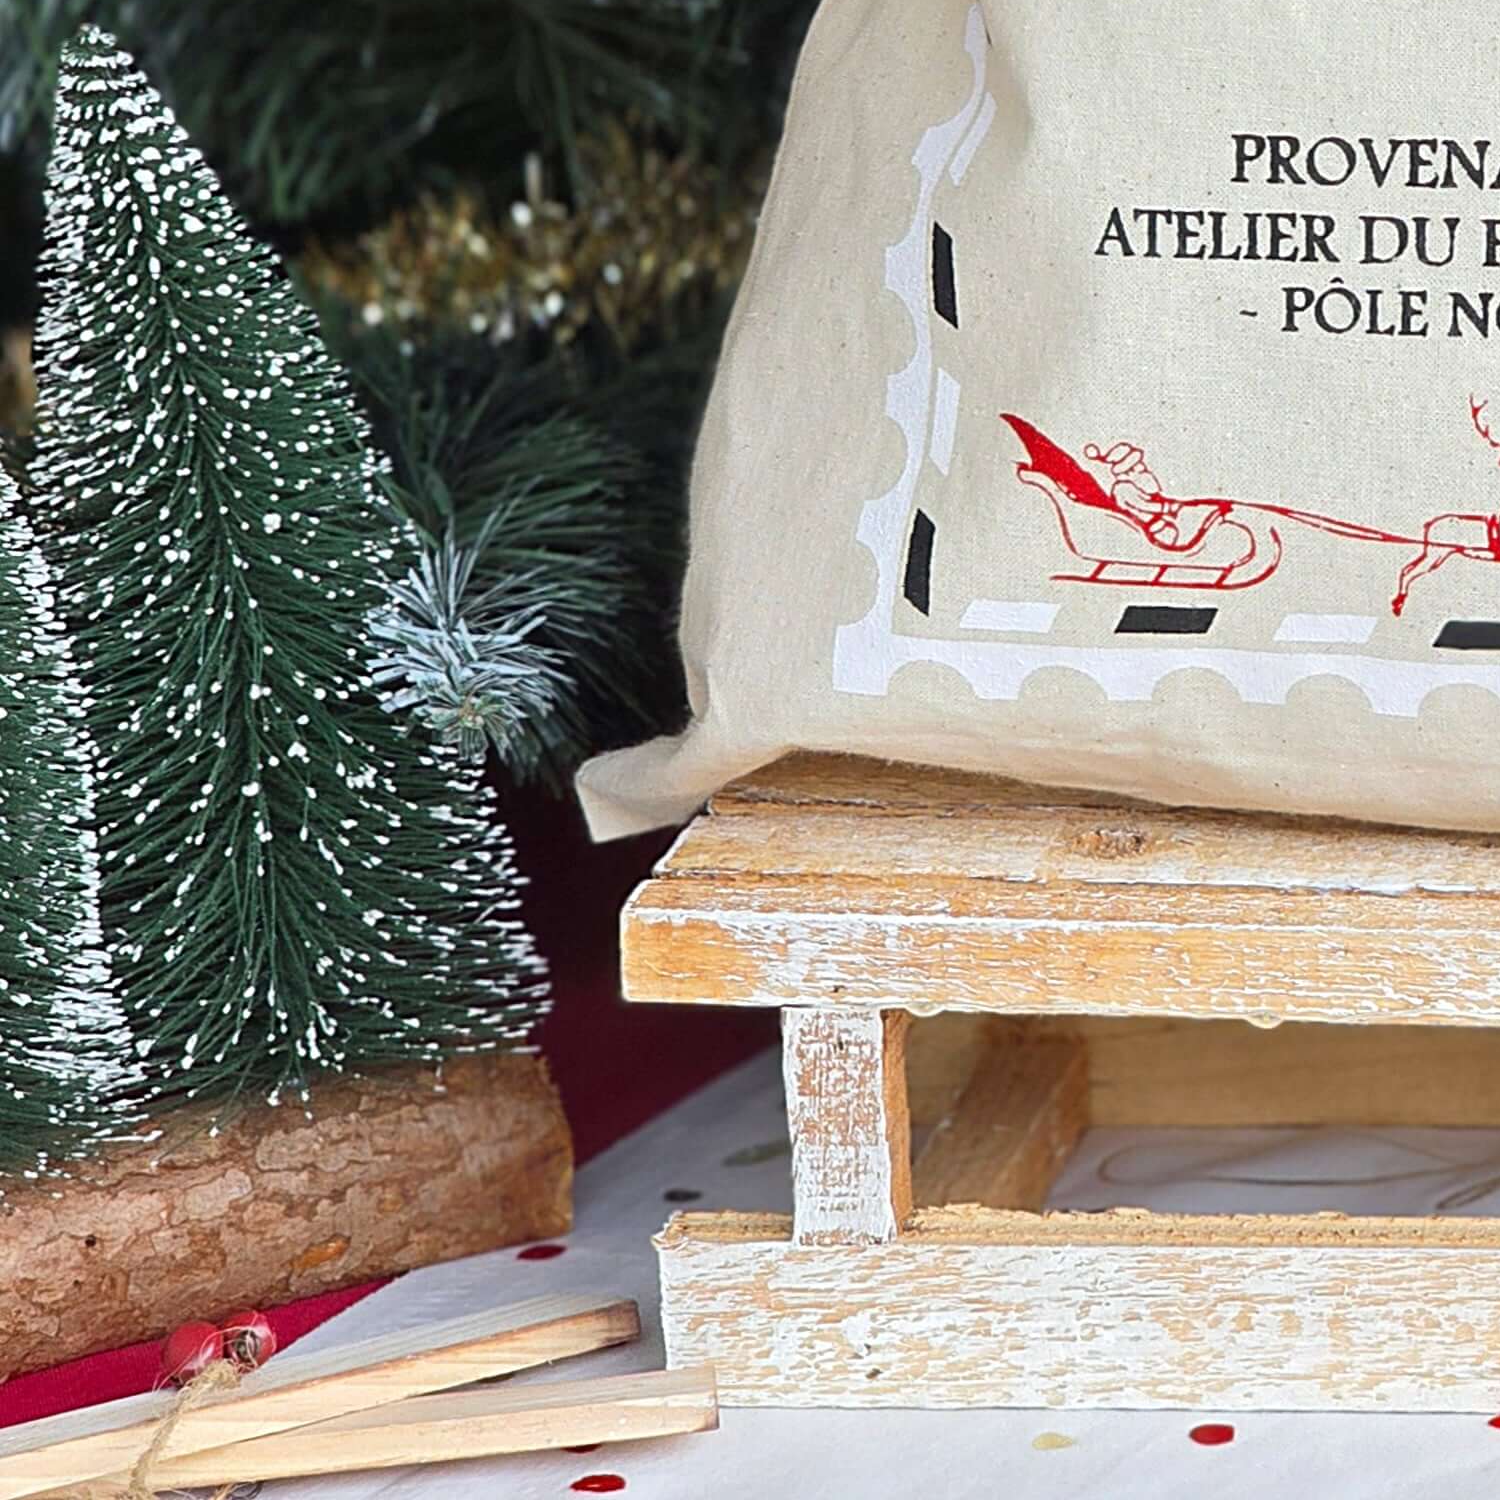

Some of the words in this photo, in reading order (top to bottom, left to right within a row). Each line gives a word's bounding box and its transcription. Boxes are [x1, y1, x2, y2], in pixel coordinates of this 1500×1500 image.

[1094, 207, 1341, 263] ATELIER
[1358, 215, 1461, 267] DU
[1281, 276, 1429, 338] PÔLE
